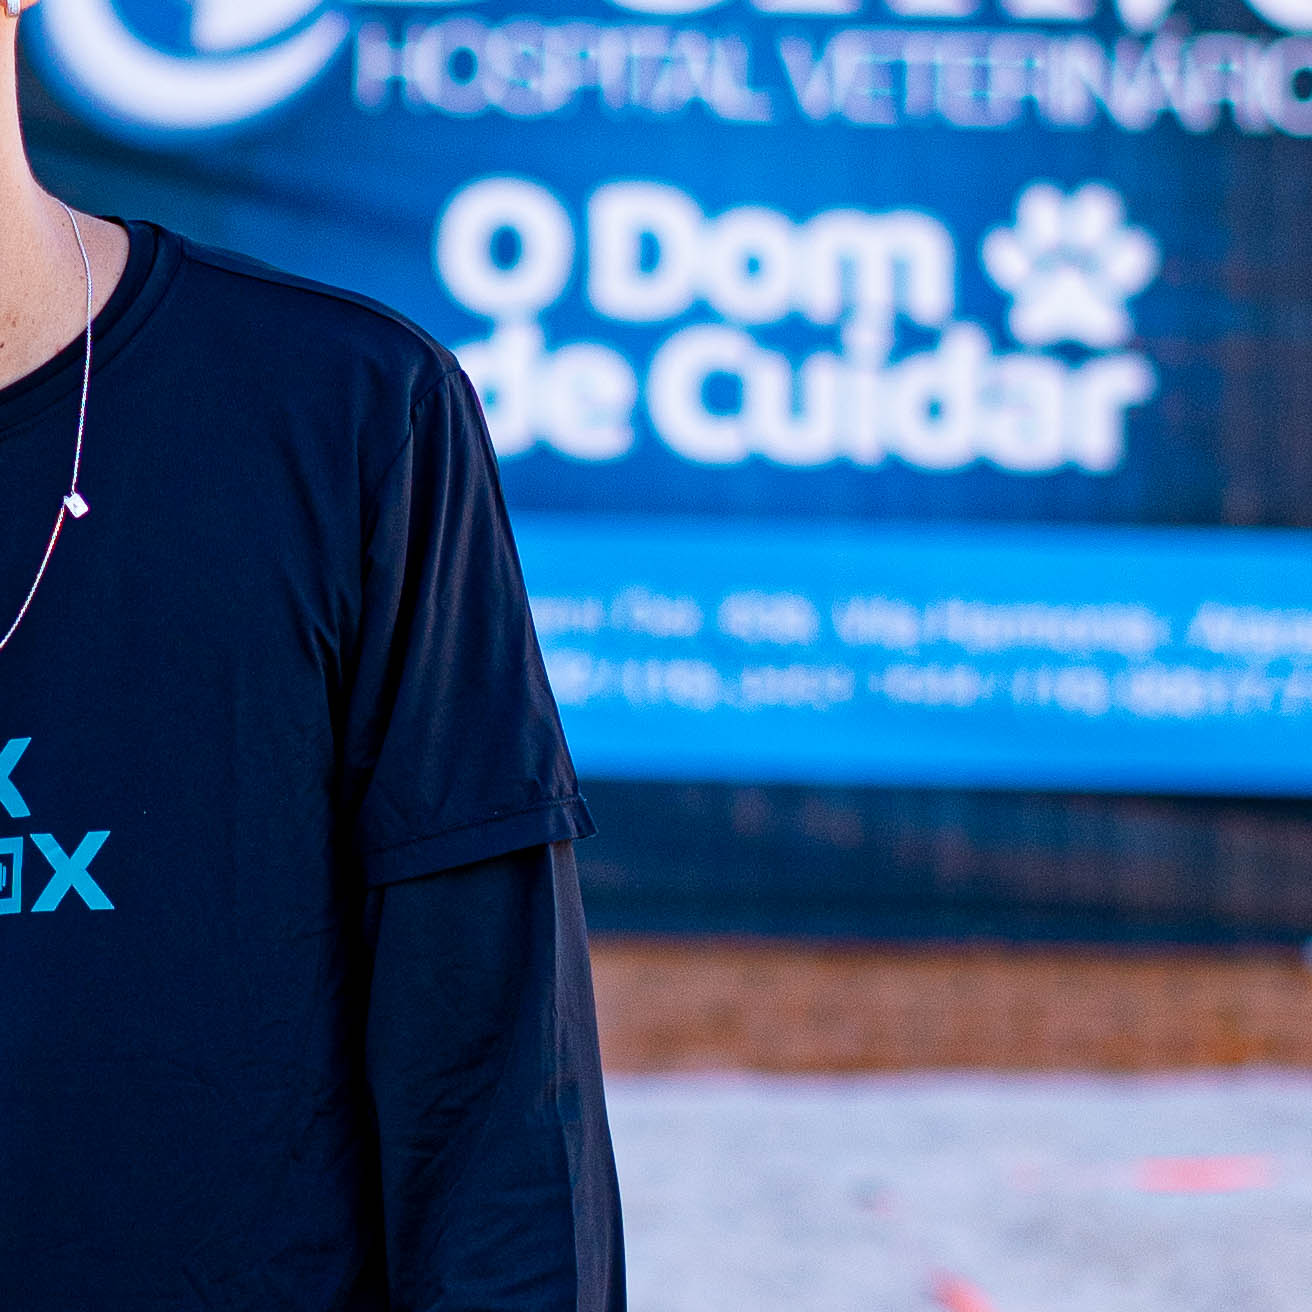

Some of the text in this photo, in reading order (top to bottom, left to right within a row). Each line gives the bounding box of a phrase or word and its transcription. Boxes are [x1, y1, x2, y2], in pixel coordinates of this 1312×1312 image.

[355, 16, 776, 125] HOSPITAL
[438, 176, 955, 330] O Dom
[456, 320, 1160, 474] de Cuidar
